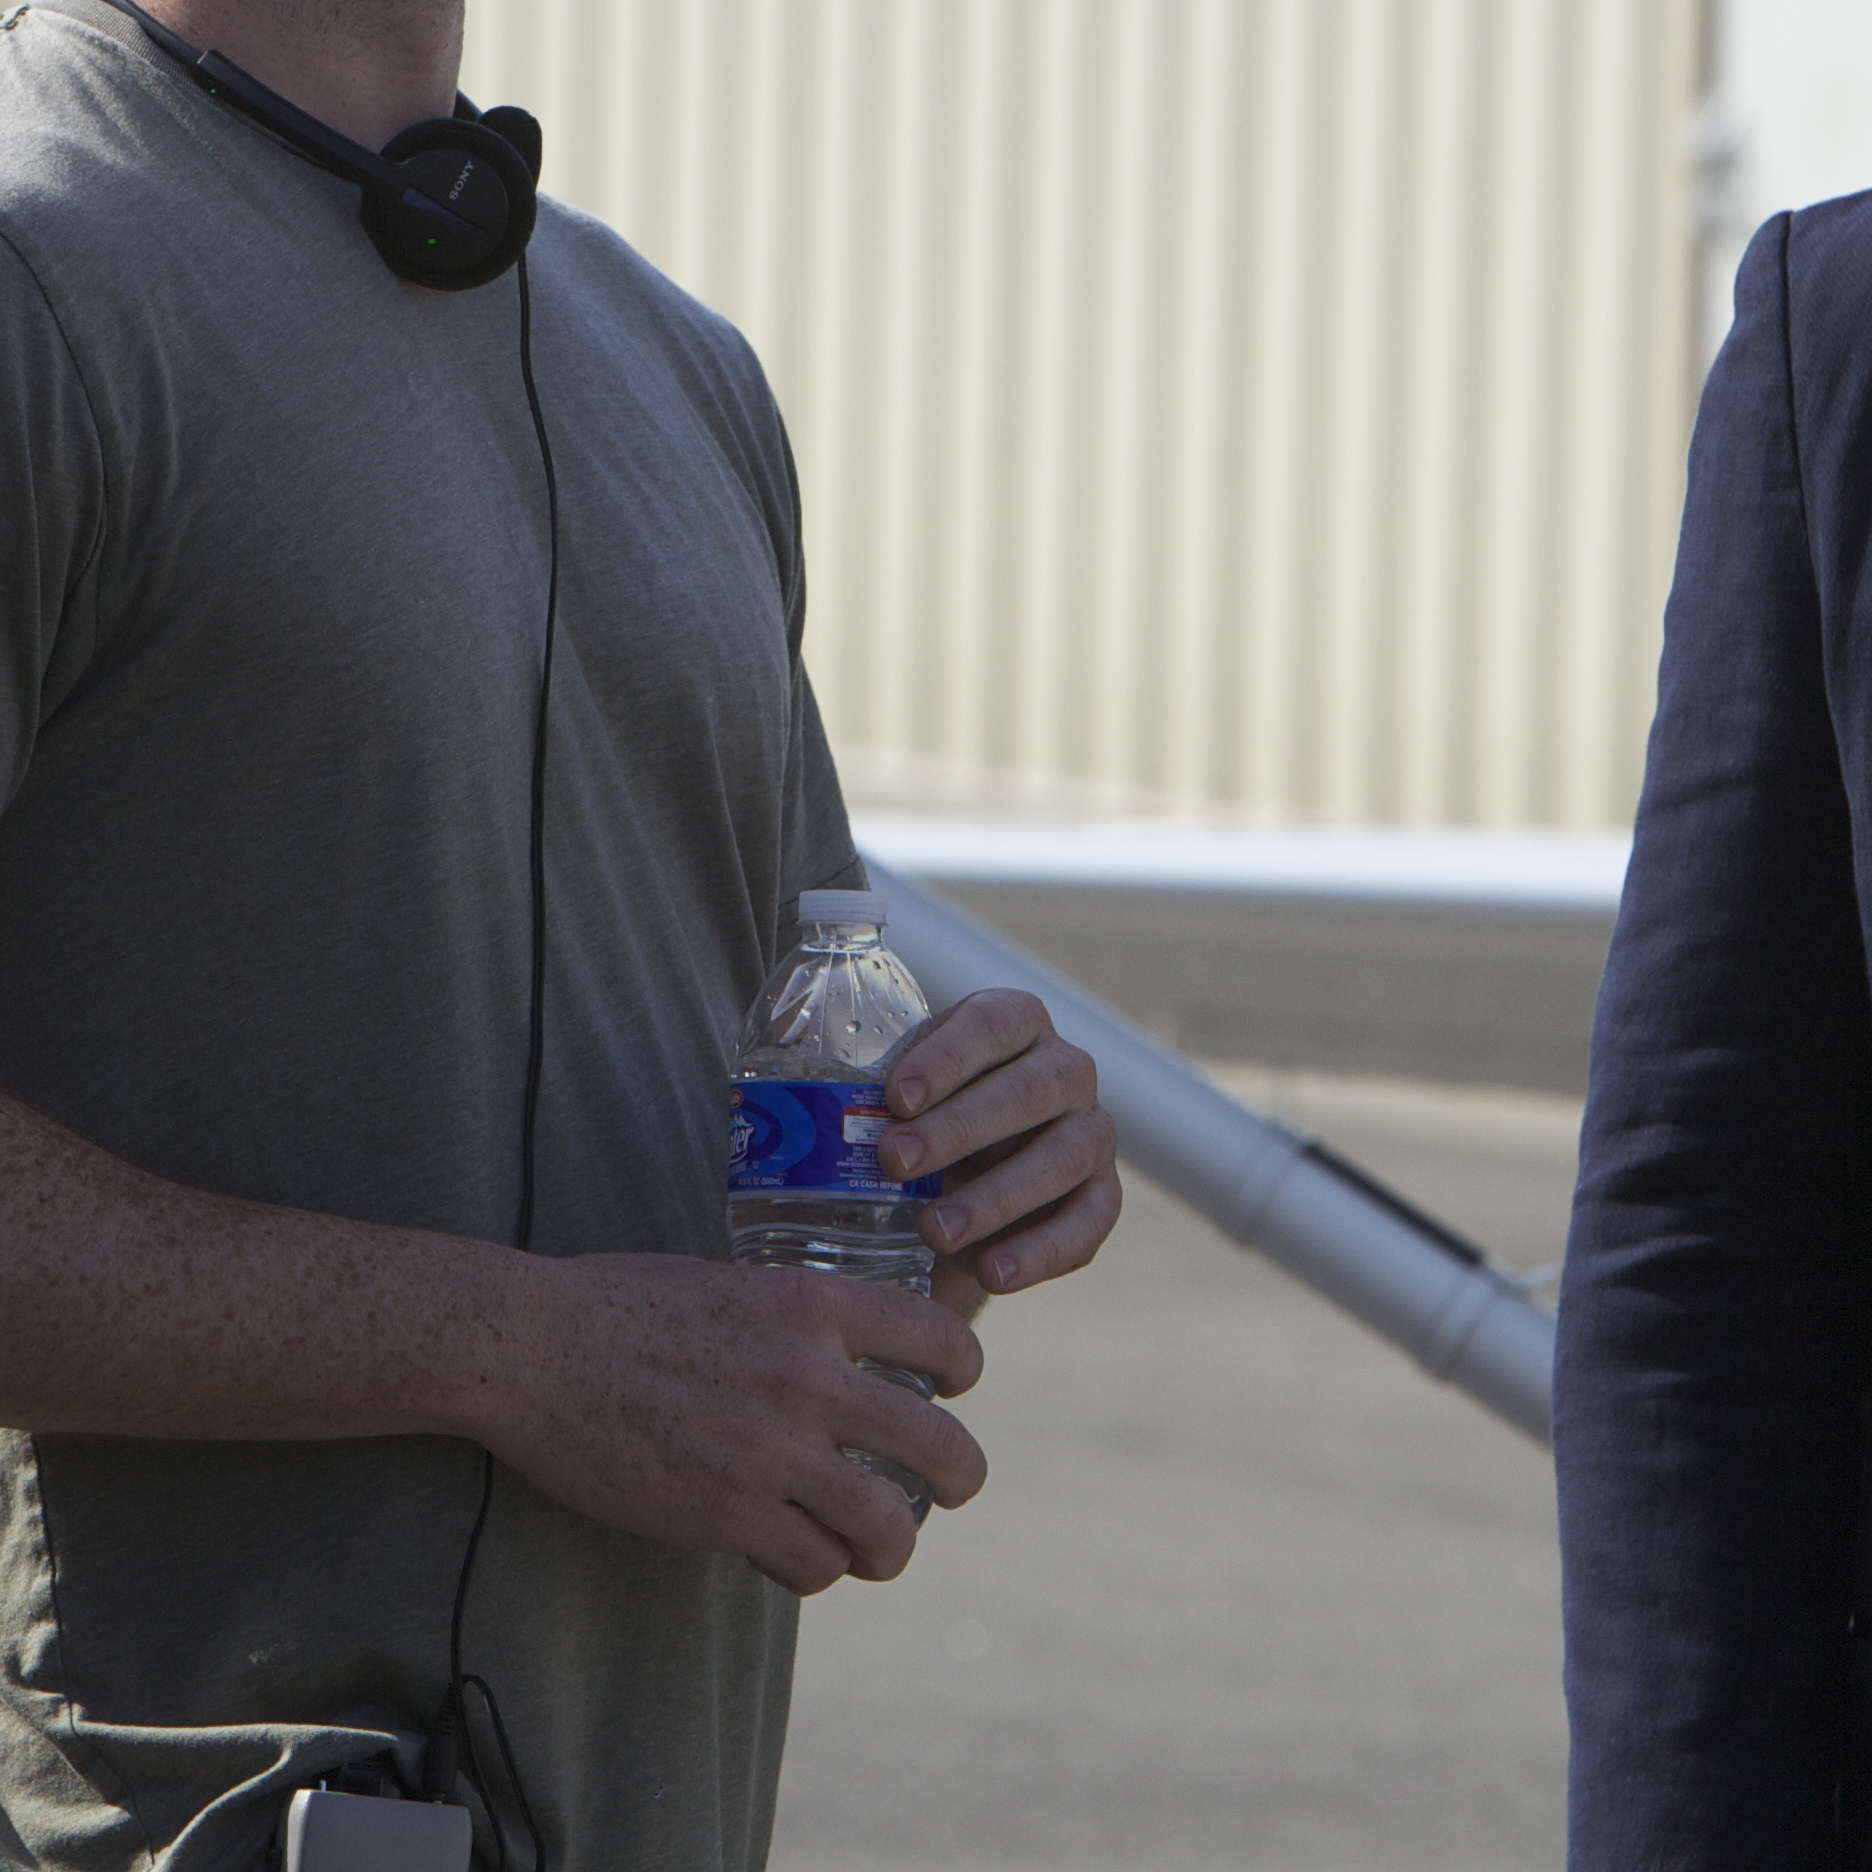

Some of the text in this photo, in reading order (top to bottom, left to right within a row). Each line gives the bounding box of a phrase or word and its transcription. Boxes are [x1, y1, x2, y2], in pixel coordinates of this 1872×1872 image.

[449, 160, 474, 200] SONY
[849, 1179, 859, 1188] CA
[860, 1180, 877, 1189] CASH
